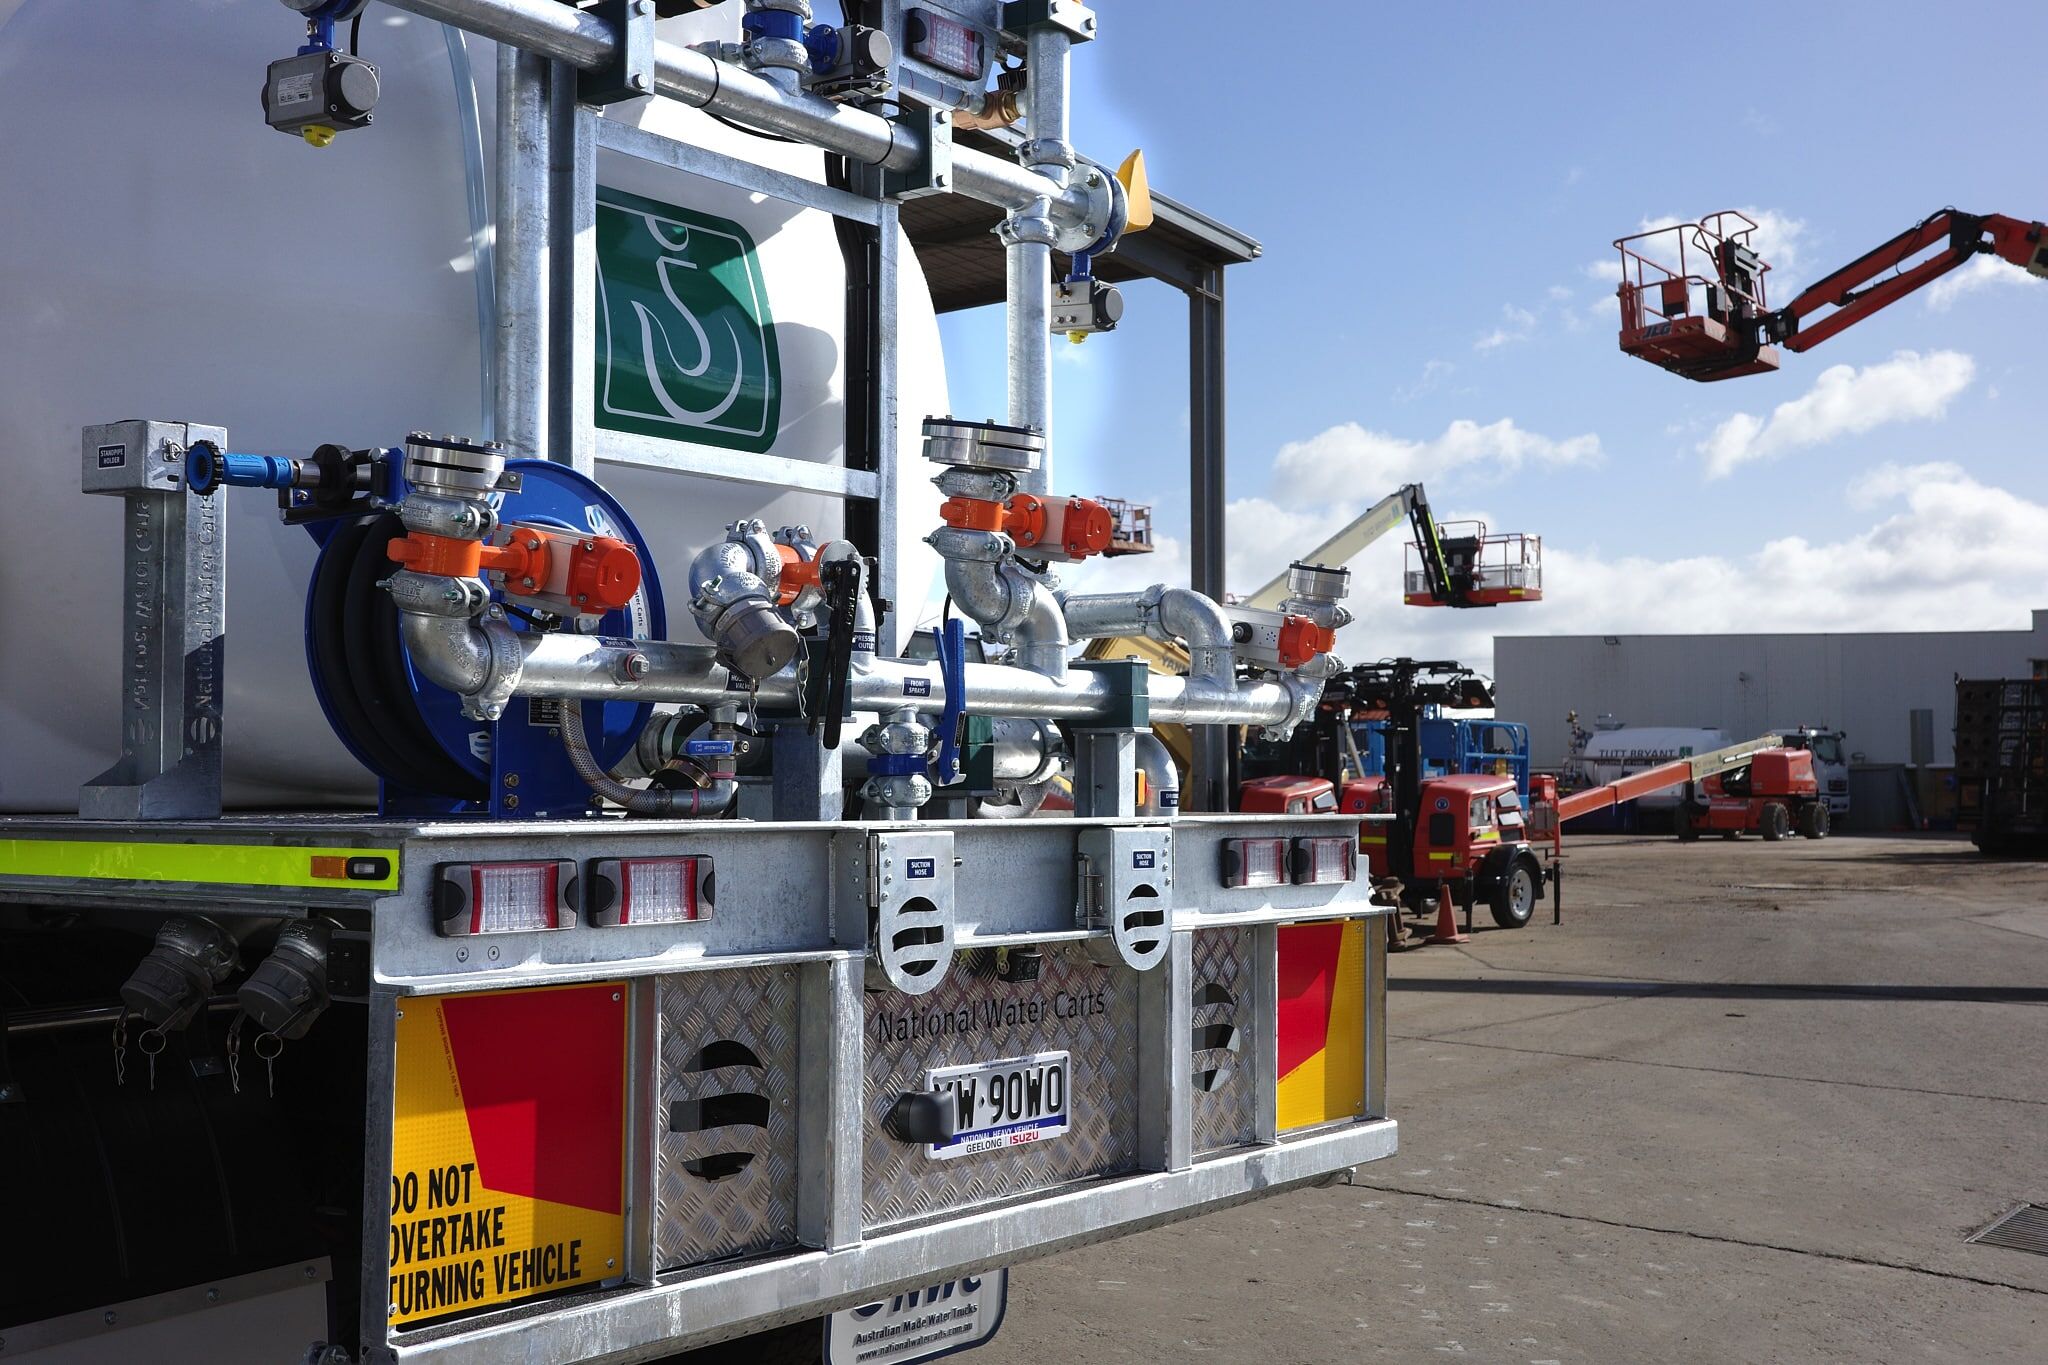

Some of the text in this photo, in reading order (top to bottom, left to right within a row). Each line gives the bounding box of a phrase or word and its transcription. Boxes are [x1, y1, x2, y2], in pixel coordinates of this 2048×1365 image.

[197, 553, 214, 614] Water
[195, 620, 213, 709] National
[1630, 749, 1675, 758] BRYANT
[878, 990, 1105, 1043] National Water Carts
[960, 1123, 1040, 1144] NATIONAL HEAVY VEHICLE
[966, 1131, 1039, 1154] GEELONG ISUZU
[428, 1163, 474, 1209] NOT
[390, 1207, 505, 1268] OVERTAKE
[493, 1239, 582, 1294] VEHICLE
[856, 1303, 978, 1345] Australian Made Water Trucks
[859, 1322, 973, 1361] www.nationalwatercarts.com.au
